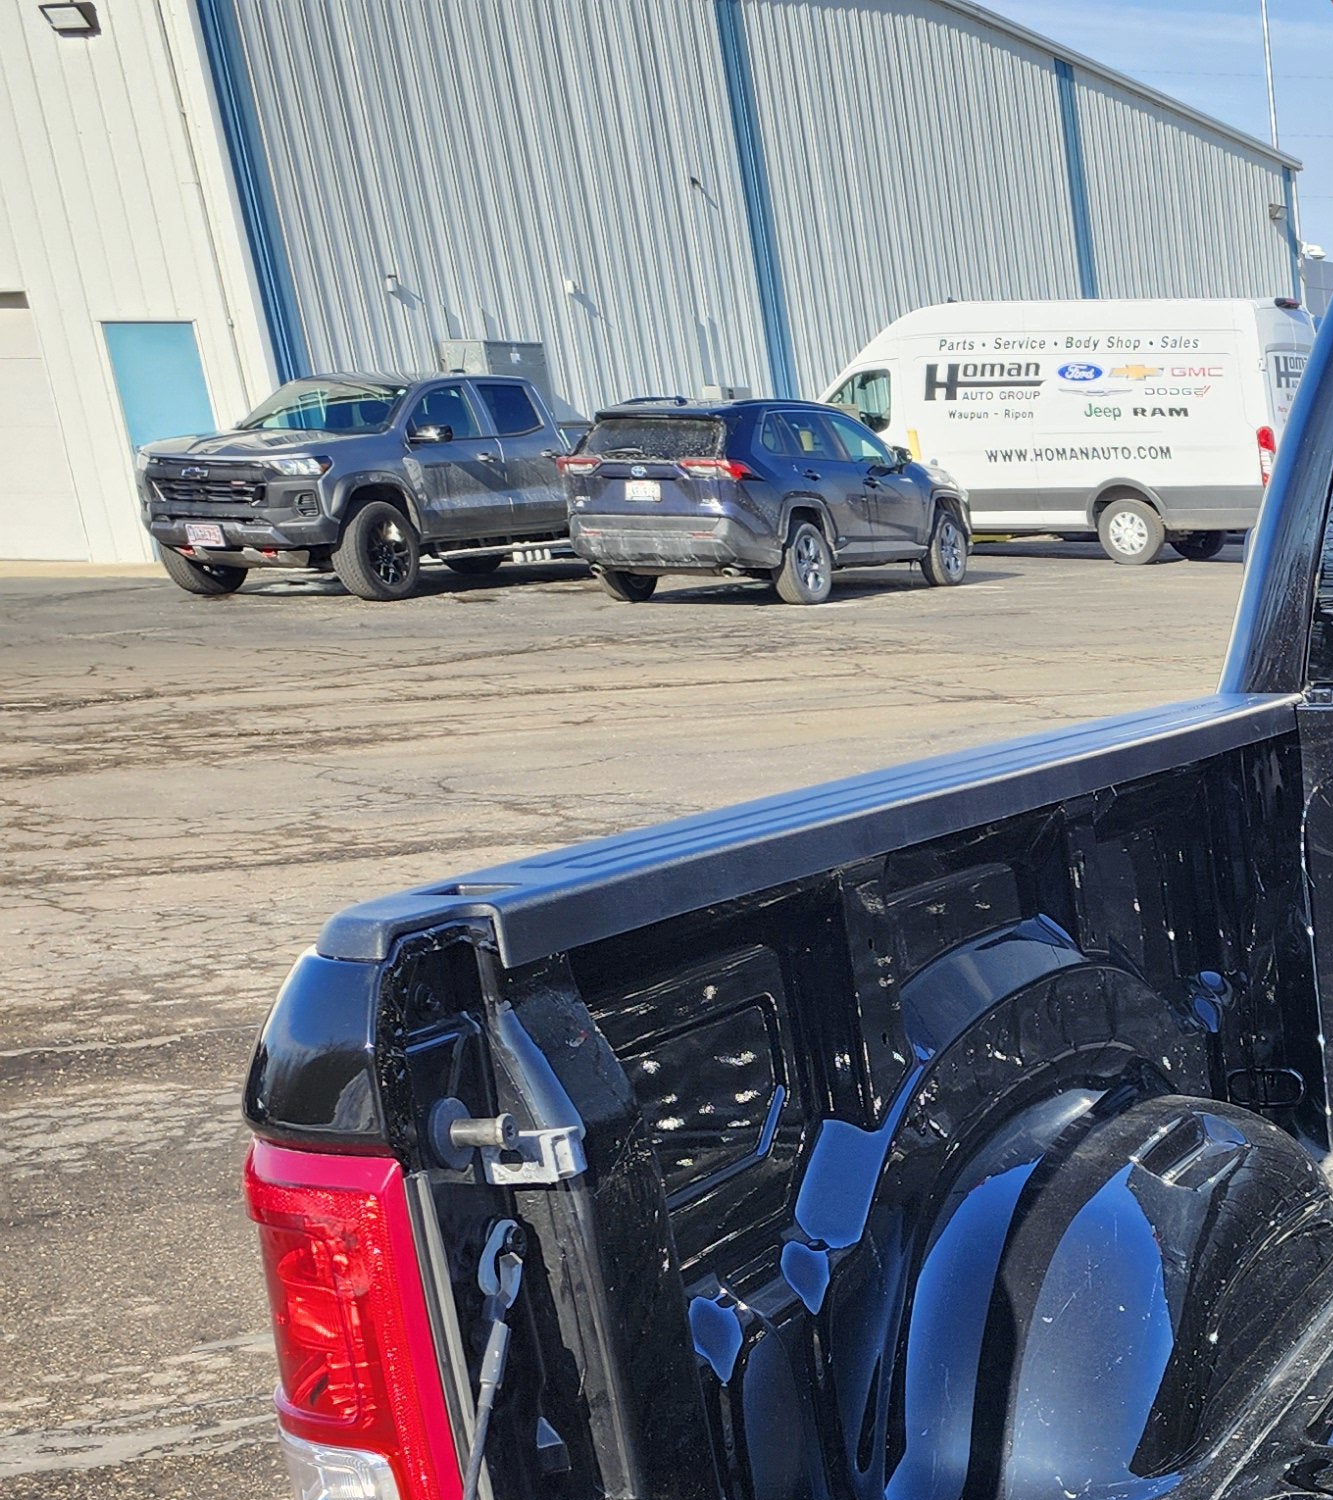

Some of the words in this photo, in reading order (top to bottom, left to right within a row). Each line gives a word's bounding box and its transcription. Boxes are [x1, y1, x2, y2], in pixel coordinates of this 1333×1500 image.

[938, 339, 975, 351] Parts
[993, 337, 1046, 350] Service
[1065, 336, 1100, 351] Body
[1107, 336, 1141, 350] Shop
[1160, 335, 1200, 349] Sales
[1061, 362, 1099, 381] Ford
[1171, 367, 1223, 377] GMC
[924, 362, 1043, 401] Homan
[962, 391, 994, 401] AUTO
[999, 390, 1041, 401] GROUP
[1144, 386, 1205, 397] DODGE
[948, 409, 989, 421] Waupun
[1004, 409, 1034, 420] Ripon
[1084, 403, 1122, 420] Jeep
[1132, 407, 1189, 417] RAM
[985, 446, 1172, 463] WWW.HOMANAUTO.COM
